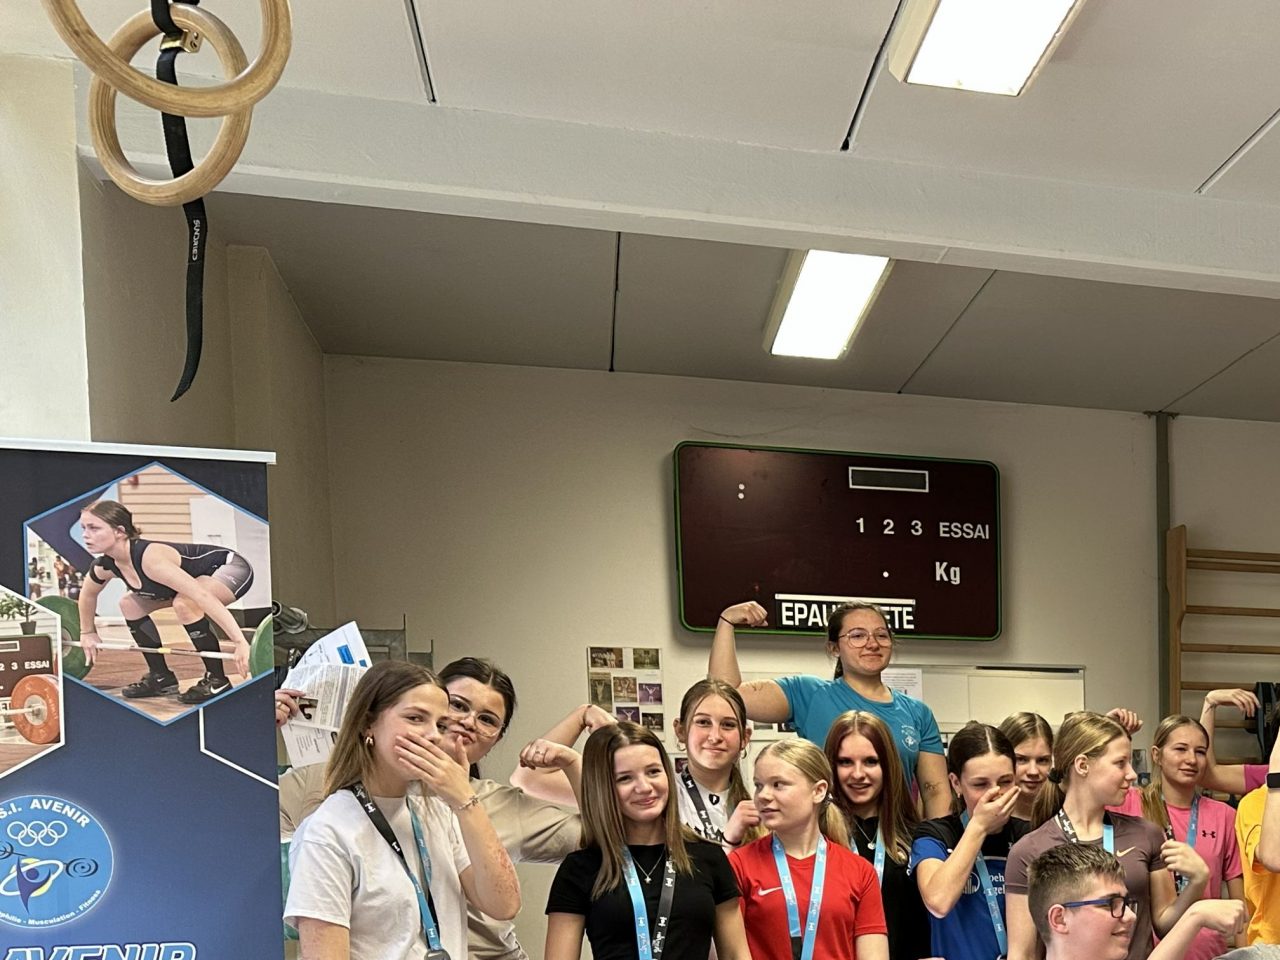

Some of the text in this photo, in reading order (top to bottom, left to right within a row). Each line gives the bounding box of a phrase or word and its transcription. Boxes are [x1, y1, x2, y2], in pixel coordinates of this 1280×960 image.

[856, 517, 990, 539] 1 2 3 ESSAI
[935, 561, 960, 585] Kg
[30, 798, 91, 828] AVENIR
